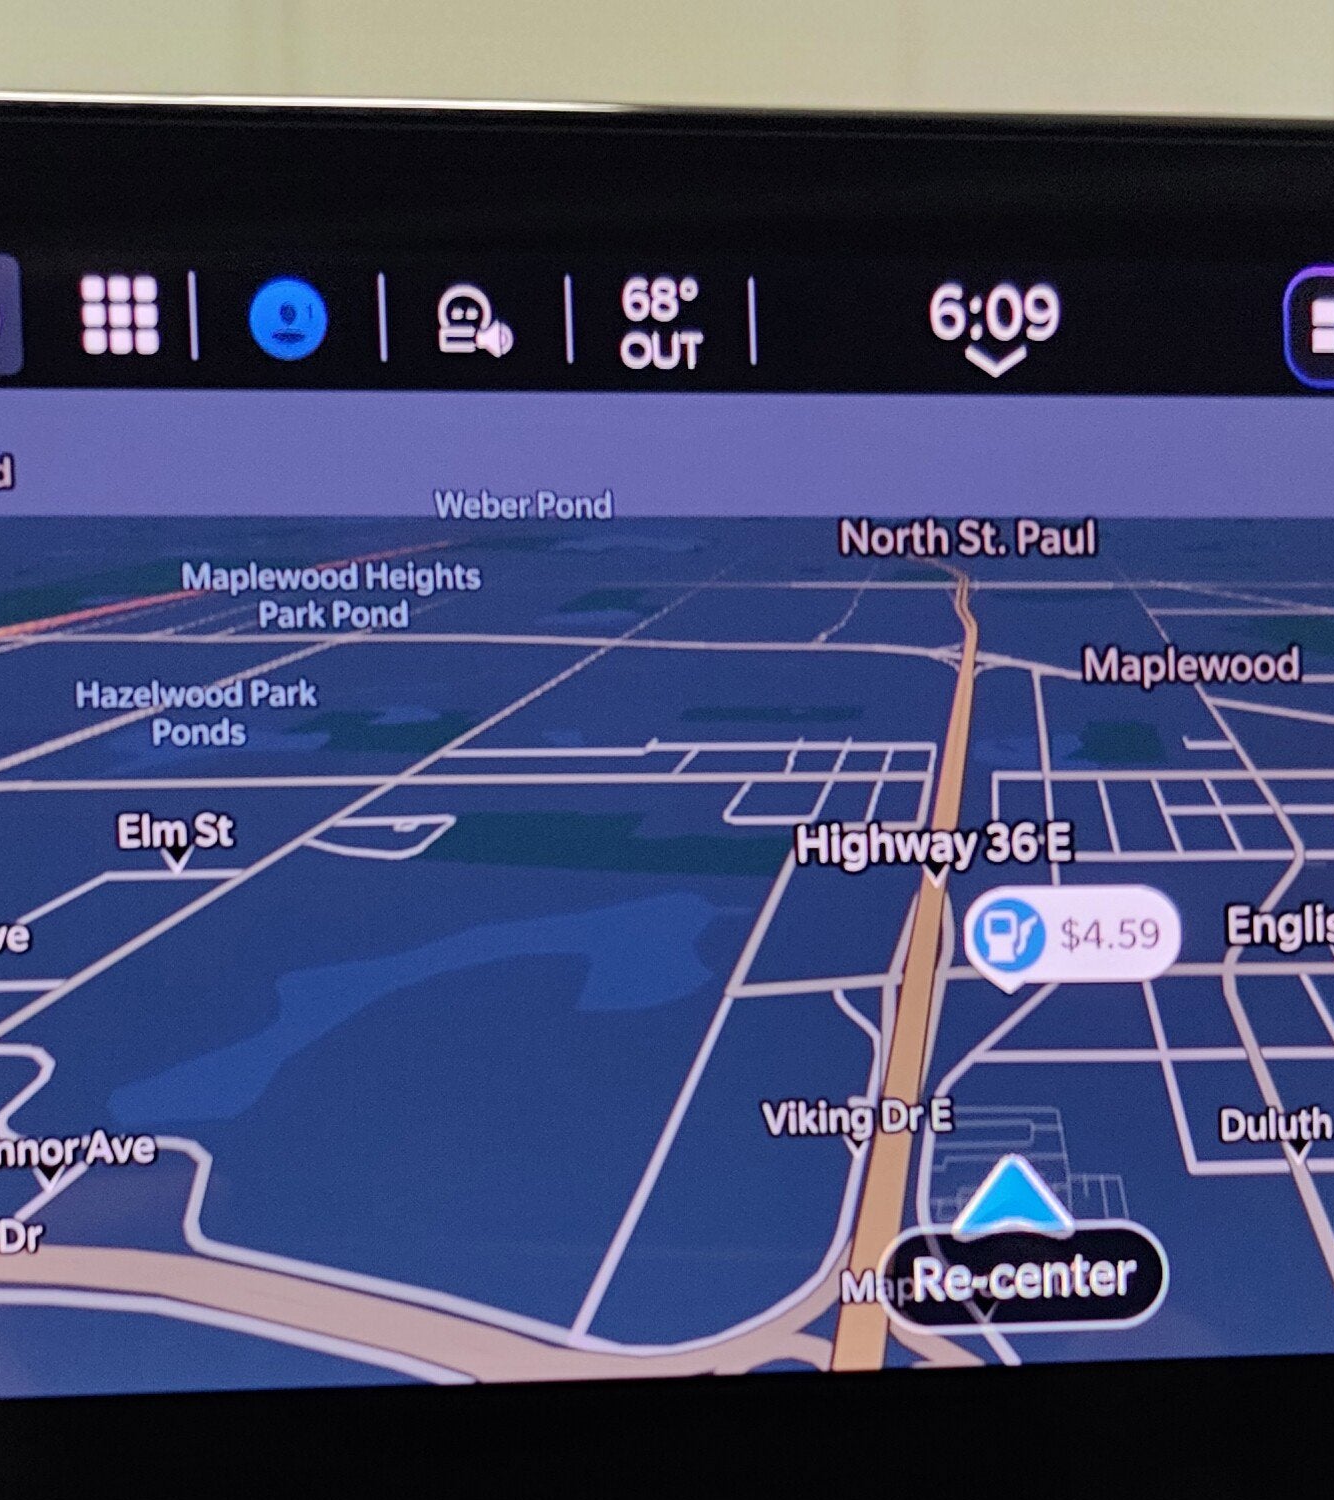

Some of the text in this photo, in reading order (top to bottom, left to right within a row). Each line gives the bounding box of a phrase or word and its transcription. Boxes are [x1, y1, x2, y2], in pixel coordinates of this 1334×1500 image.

[621, 275, 699, 323] 68°
[929, 281, 1061, 342] 6:09
[620, 331, 705, 371] OUT
[434, 489, 613, 520] Weber Pond
[839, 518, 1097, 557] North St. Paul
[181, 562, 482, 598] Maplewood Heights
[258, 600, 410, 630] Park Pond
[1083, 646, 1302, 689] Maplewood
[75, 679, 318, 710] Hazelwood Park
[152, 717, 247, 748] Ponds
[117, 813, 235, 849] Elm St
[796, 822, 1073, 871] Highway 36 E
[1059, 916, 1162, 952] $4.59
[762, 1098, 954, 1139] Viking Dr E
[1220, 1109, 1333, 1143] Duluth
[84, 1130, 157, 1165] Ave
[913, 1253, 1138, 1303] Re-center
